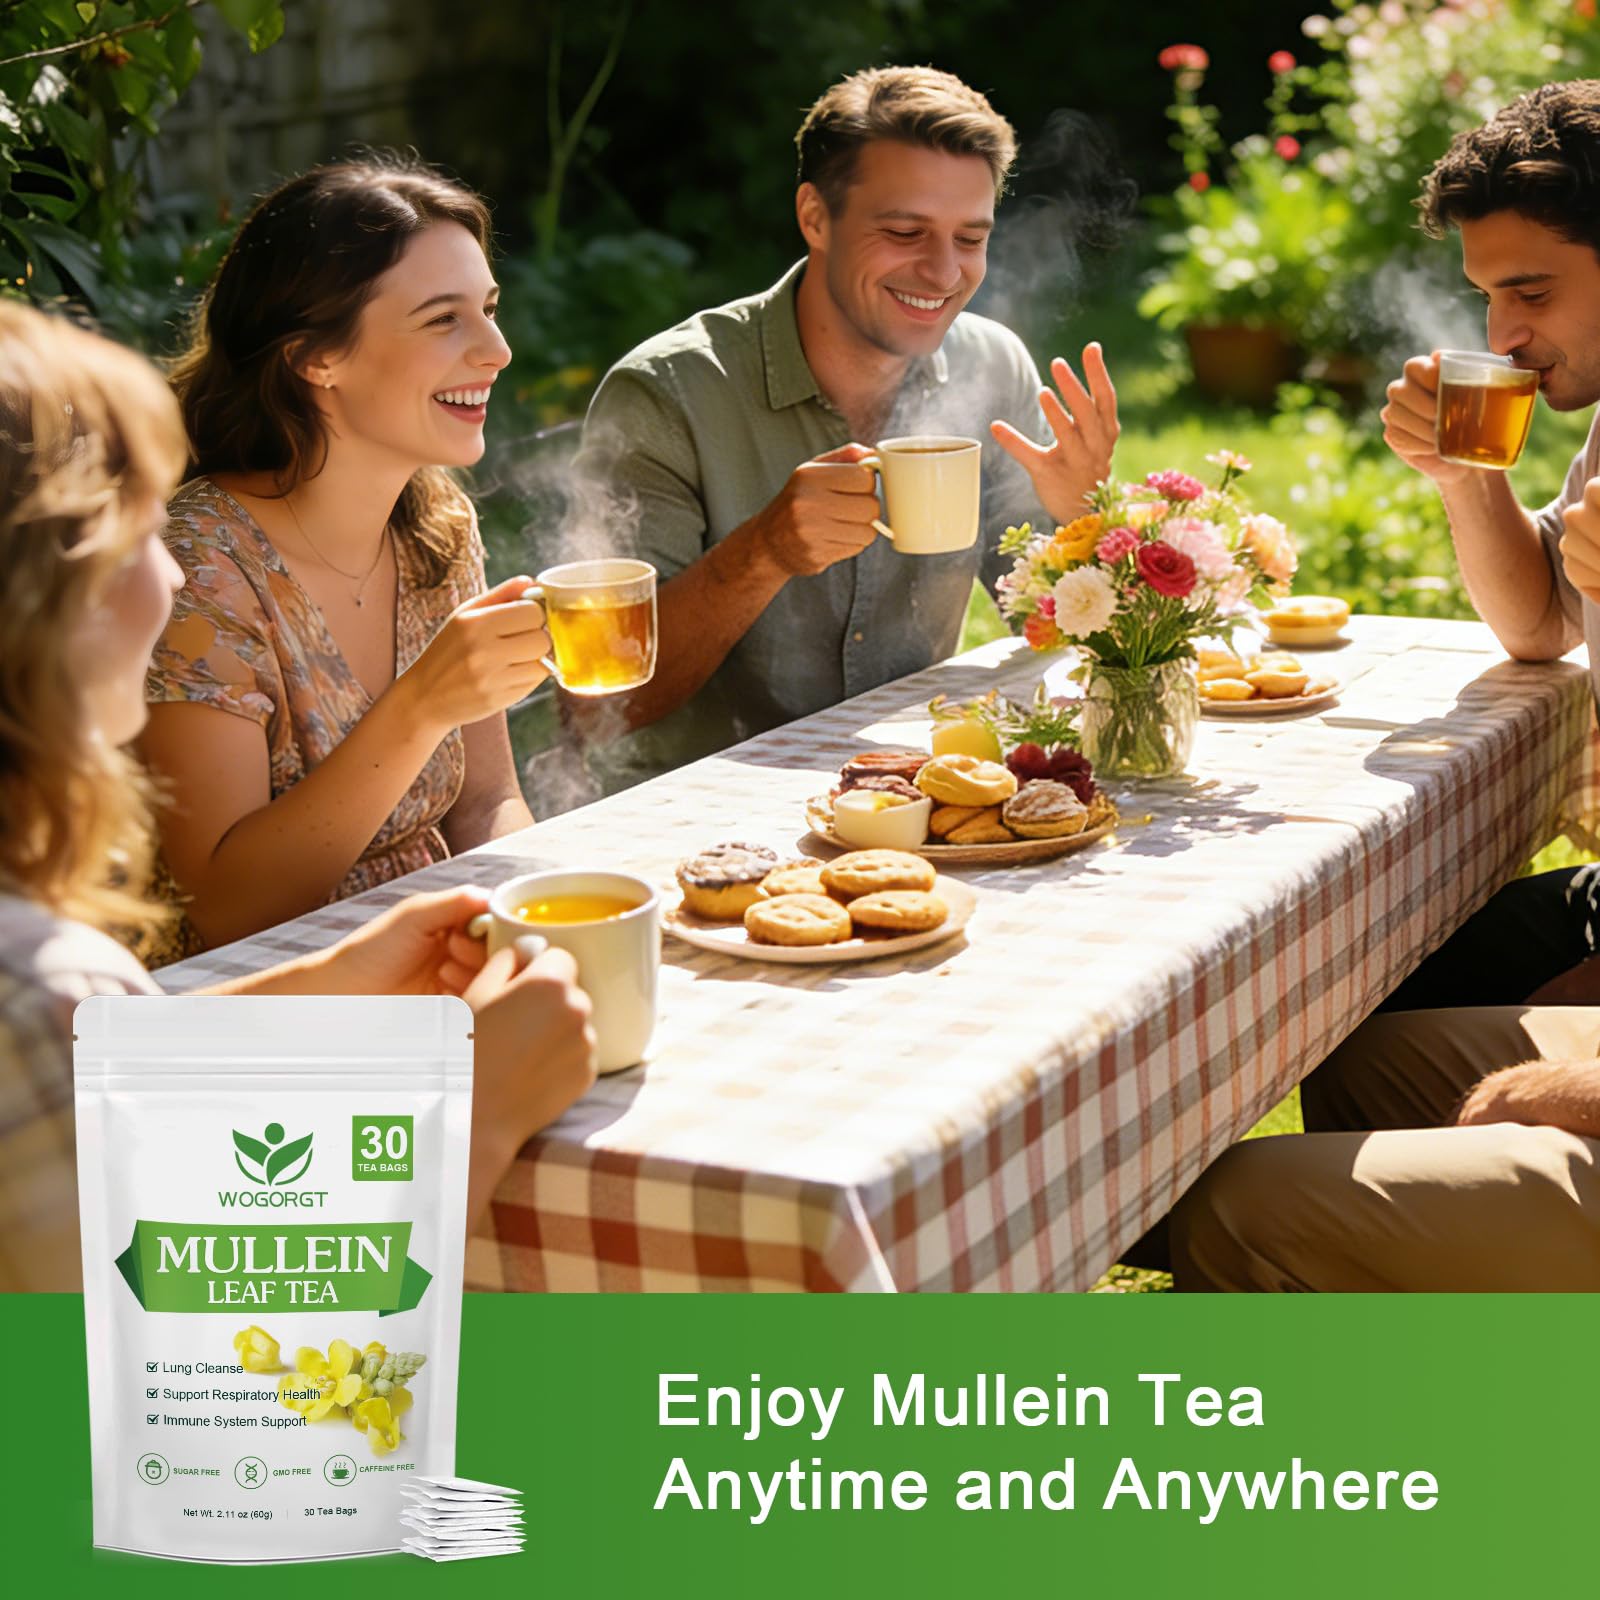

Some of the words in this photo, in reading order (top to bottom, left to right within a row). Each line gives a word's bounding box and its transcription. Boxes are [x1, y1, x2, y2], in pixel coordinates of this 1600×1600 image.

[361, 1126, 407, 1159] 30
[358, 1164, 377, 1172] TEA
[218, 1192, 328, 1207] WOGORGT
[157, 1236, 392, 1273] MULLEIN
[208, 1281, 276, 1303] LEAF
[285, 1281, 339, 1303] TEA
[164, 1363, 191, 1375] Lung
[196, 1363, 243, 1373] Cleanse
[164, 1389, 209, 1402] Support
[213, 1390, 279, 1402] Respiratory
[284, 1389, 320, 1400] Health
[164, 1415, 210, 1426] Immune
[215, 1416, 257, 1428] System
[262, 1416, 306, 1429] Support
[173, 1467, 199, 1476] SUGAR
[201, 1468, 221, 1477] FREE
[272, 1468, 290, 1477] GMO
[292, 1468, 312, 1476] FREE
[359, 1464, 395, 1473] CAFFEINE
[396, 1463, 415, 1471] FREE
[251, 1511, 272, 1520] (60g)
[336, 1507, 357, 1516] Bags
